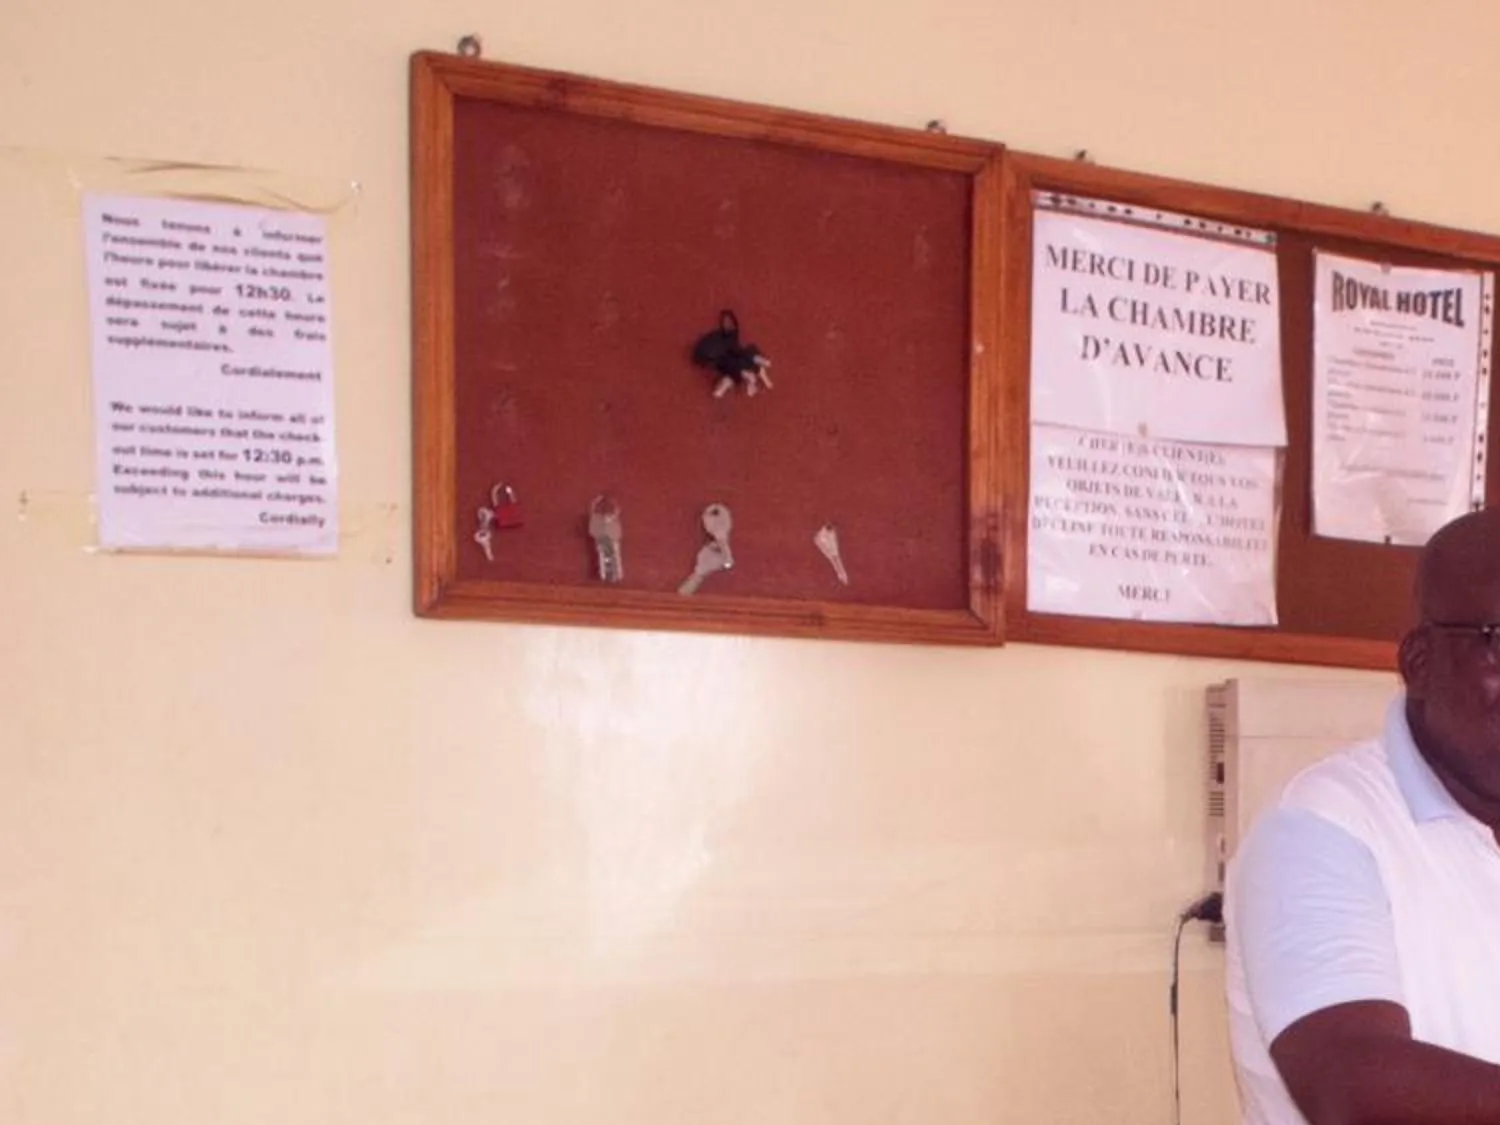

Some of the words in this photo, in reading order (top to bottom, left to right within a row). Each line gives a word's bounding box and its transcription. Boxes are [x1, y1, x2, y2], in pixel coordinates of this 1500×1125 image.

[102, 213, 139, 227] Nous
[161, 218, 211, 234] tenons
[262, 229, 323, 243] informer
[188, 241, 206, 251] de
[212, 244, 238, 255] nos
[244, 246, 291, 260] clients
[297, 252, 323, 263] que
[158, 258, 191, 270] pour
[245, 264, 258, 275] la
[261, 266, 324, 280] chambre
[1046, 244, 1135, 282] MERCI
[1143, 262, 1177, 289] DE
[1185, 271, 1271, 306] PAYER
[104, 277, 128, 287] est
[189, 284, 223, 296] pour
[1331, 269, 1392, 313] ROYAL
[1396, 287, 1466, 329] HOTEL
[212, 305, 230, 316] de
[240, 309, 276, 320] cette
[285, 310, 325, 323] heure
[1060, 287, 1098, 319] LA
[1108, 295, 1257, 344] CHAMBRE
[106, 317, 139, 328] sera
[161, 320, 197, 334] sujet
[248, 326, 274, 337] des
[1081, 334, 1234, 383] D'AVANCE
[220, 363, 322, 381] Cordialement
[111, 401, 133, 413] We
[138, 405, 182, 417] would
[186, 406, 213, 417] like
[218, 409, 233, 419] to
[238, 410, 284, 422] inform
[111, 423, 134, 432] our
[138, 424, 216, 438] customers
[220, 428, 248, 439] that
[252, 430, 275, 440] the
[112, 446, 136, 457] out
[140, 447, 172, 458] time
[193, 450, 214, 460] set
[242, 448, 292, 464] 12:30
[113, 464, 190, 482] Exceeding
[198, 469, 226, 481] this
[234, 470, 267, 482] hour
[308, 475, 327, 485] be
[114, 484, 168, 498] subject
[172, 486, 187, 497] to
[192, 488, 263, 500] additional
[1066, 479, 1121, 497] OBJETS
[259, 511, 326, 530] Cordially
[1117, 585, 1172, 603] MERCI
